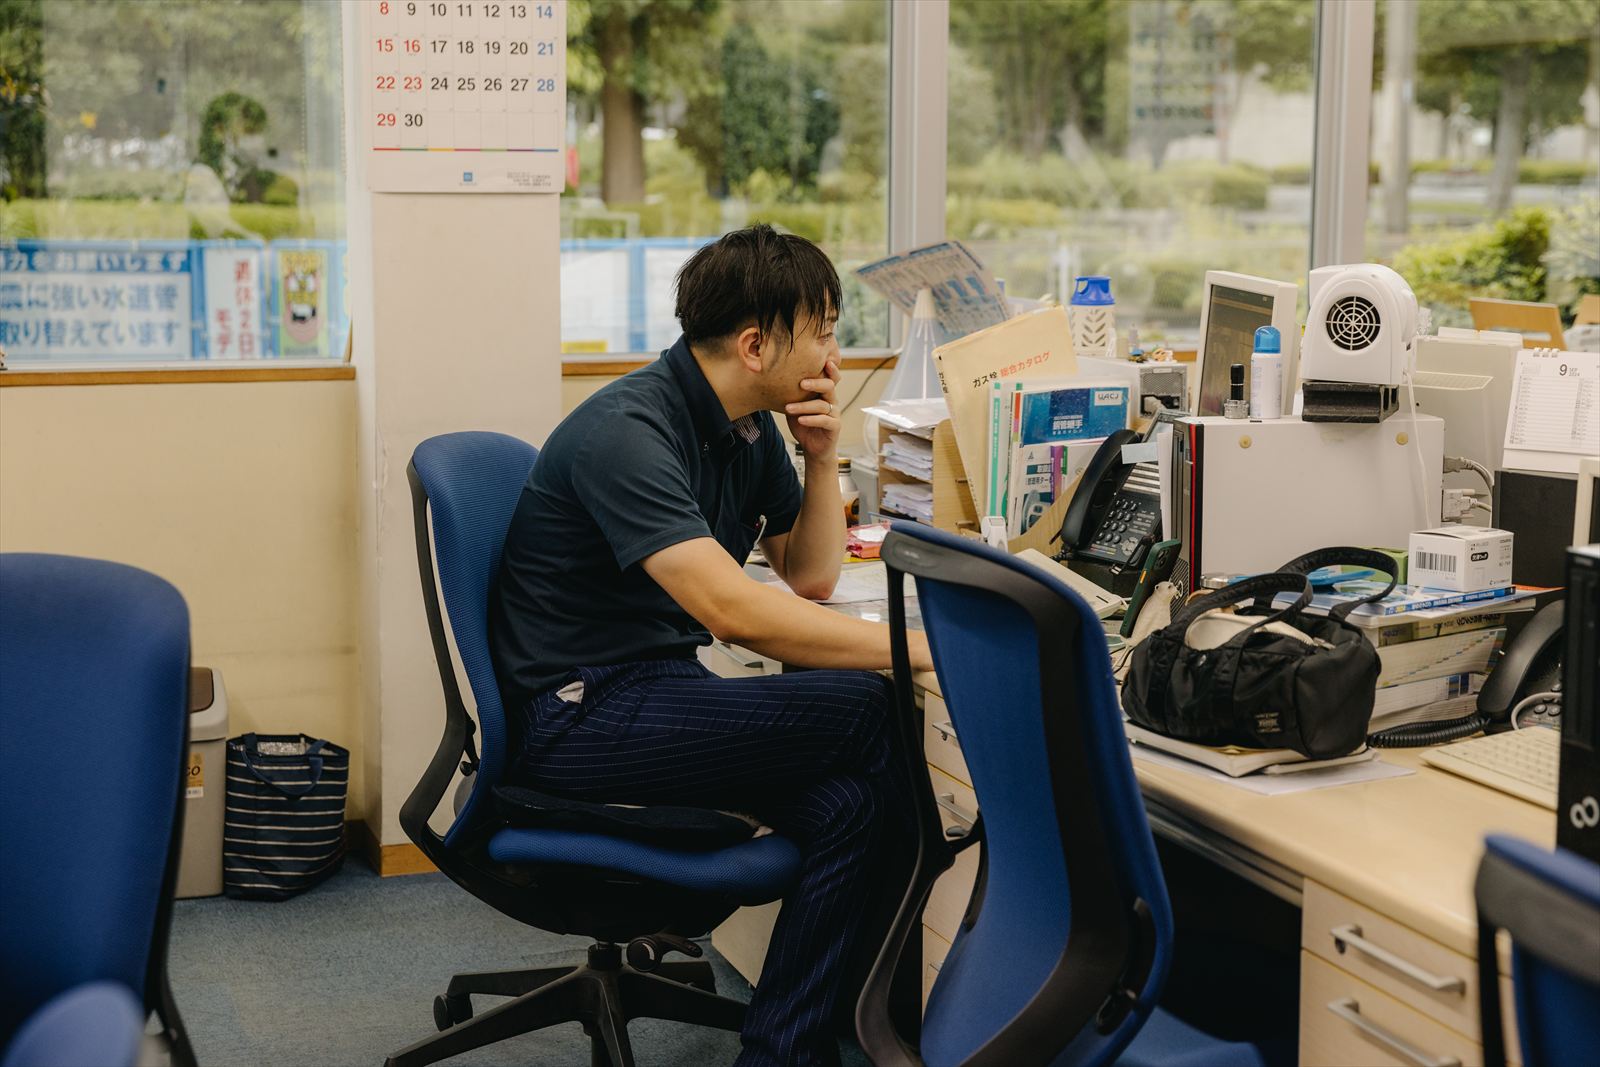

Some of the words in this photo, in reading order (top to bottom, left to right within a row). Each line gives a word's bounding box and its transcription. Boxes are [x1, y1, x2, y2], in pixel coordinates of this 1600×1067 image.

[380, 2, 388, 15] 8
[407, 2, 416, 16] 9
[430, 3, 447, 16] 10
[457, 4, 472, 17] 11
[484, 5, 500, 18] 12
[510, 5, 526, 18] 13
[537, 6, 552, 18] 14
[377, 39, 393, 52] 15
[404, 40, 420, 53] 16
[431, 40, 447, 53] 17
[457, 41, 474, 54] 18
[484, 41, 500, 54] 19
[510, 42, 528, 55] 20
[538, 43, 554, 55] 21
[376, 76, 395, 90] 22
[404, 77, 422, 90] 23
[431, 77, 448, 90] 24
[457, 78, 475, 91] 25
[484, 78, 502, 91] 26
[511, 79, 528, 92] 27
[537, 80, 555, 92] 28
[377, 113, 396, 126] 29
[404, 114, 423, 127] 30
[0, 250, 187, 272] 力をお願いします
[0, 319, 180, 346] 取り替えています
[999, 351, 1051, 378] 総合カタログ
[1559, 364, 1568, 376] 9
